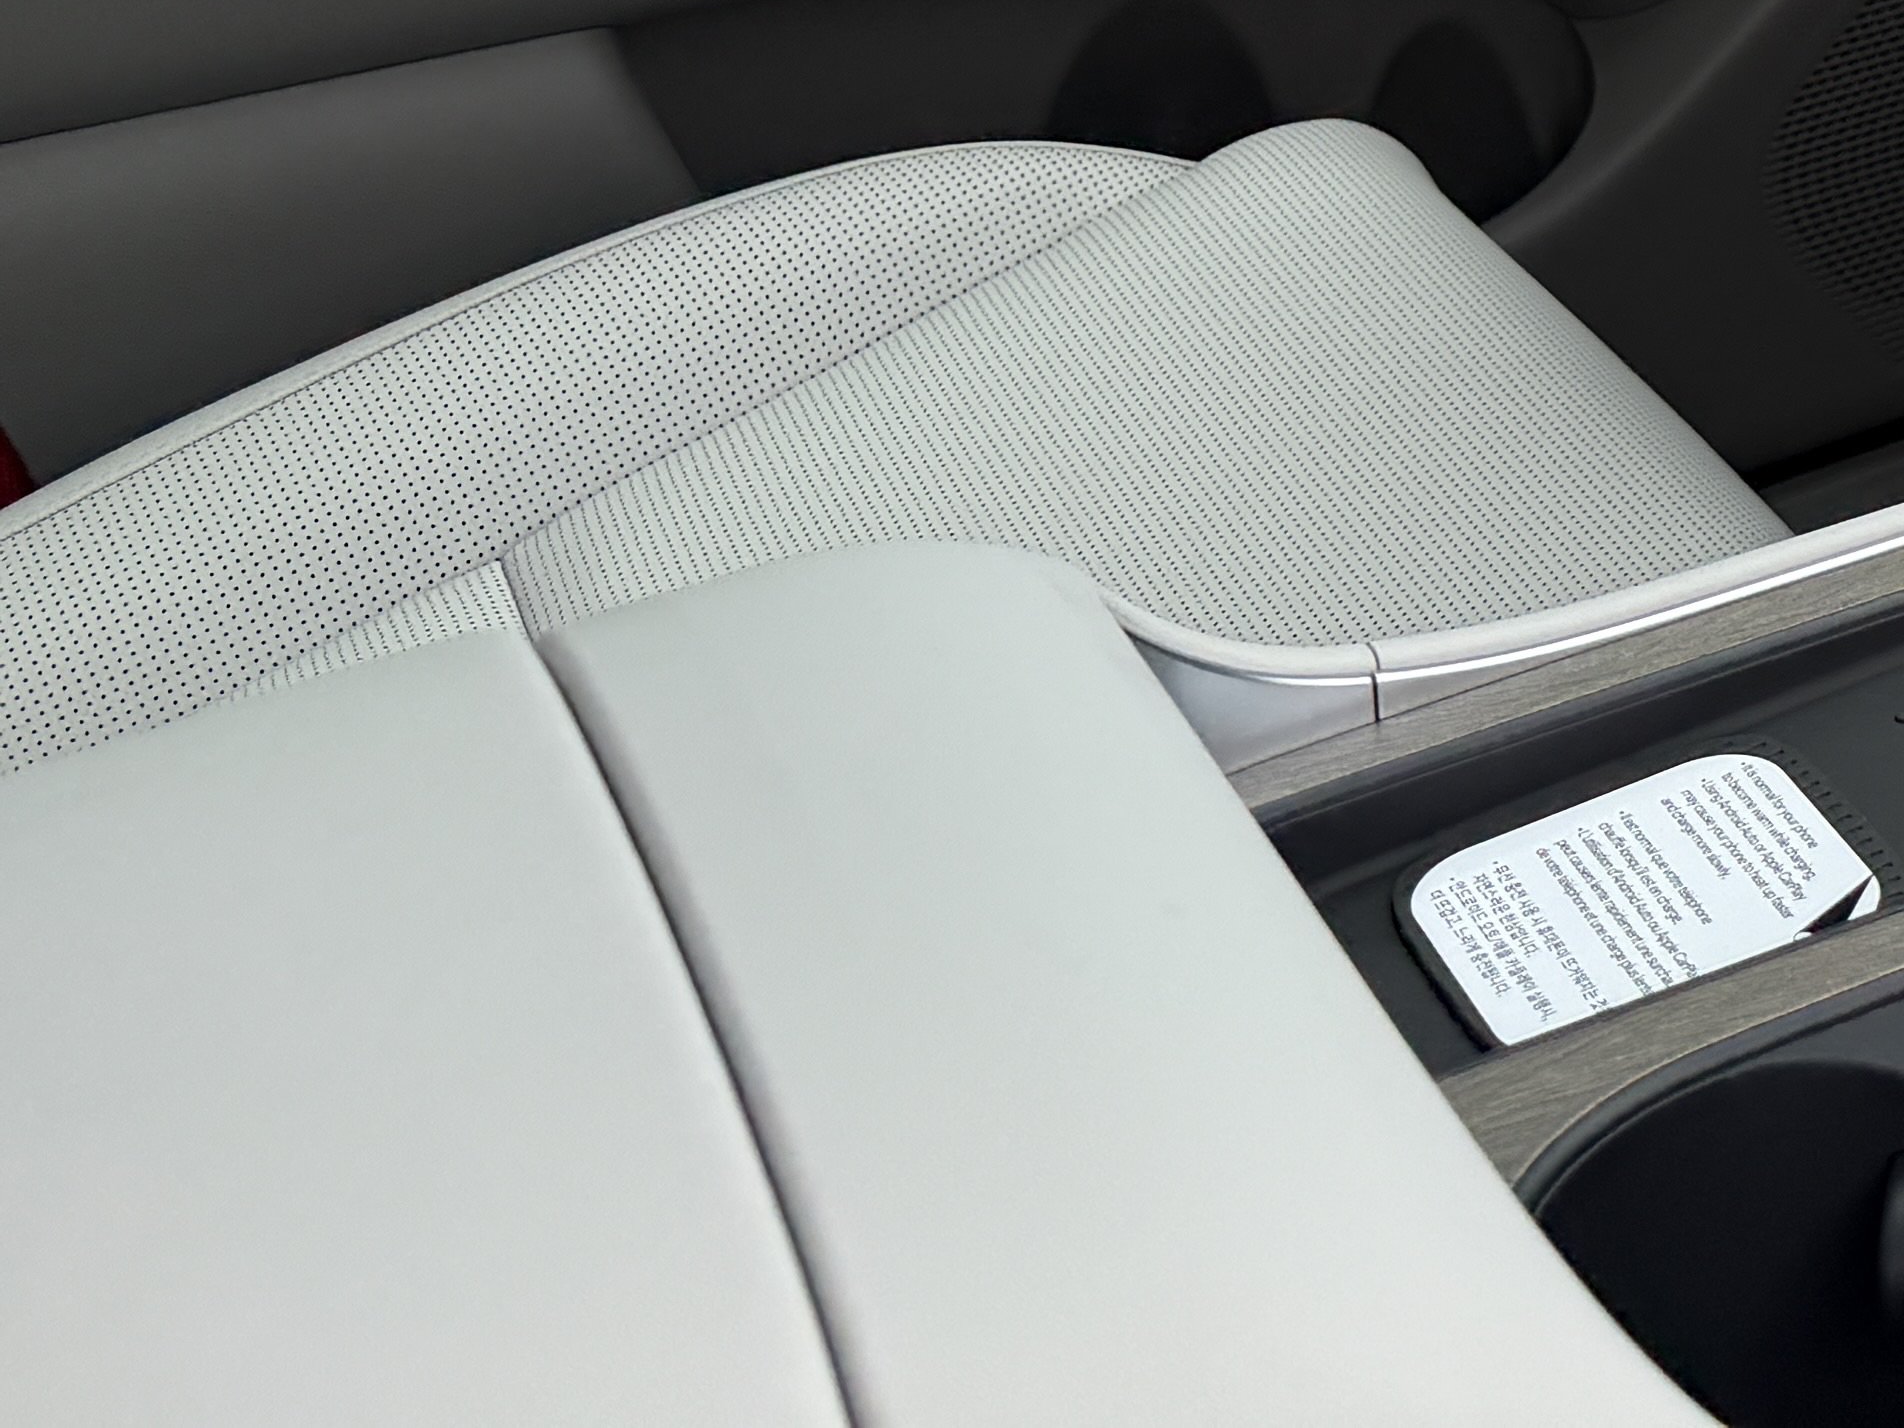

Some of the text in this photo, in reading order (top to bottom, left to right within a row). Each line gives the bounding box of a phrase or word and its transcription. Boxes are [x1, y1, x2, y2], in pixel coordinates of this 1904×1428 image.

[1726, 778, 1761, 809] become
[1749, 774, 1781, 801] normal
[1774, 807, 1800, 827] your
[1789, 823, 1821, 850] phone
[1629, 827, 1662, 855] normal
[1647, 853, 1670, 871] que
[1666, 809, 1701, 837] charge
[1688, 833, 1714, 855] more
[1715, 798, 1750, 829] Android
[1737, 824, 1764, 846] Auto
[1756, 850, 1788, 875] Apple
[1772, 870, 1811, 903] CarPlay
[1705, 823, 1730, 842] your
[1718, 837, 1752, 866] phone
[1757, 887, 1776, 900] up
[1594, 932, 1633, 963] charge
[1651, 929, 1684, 955] Apple
